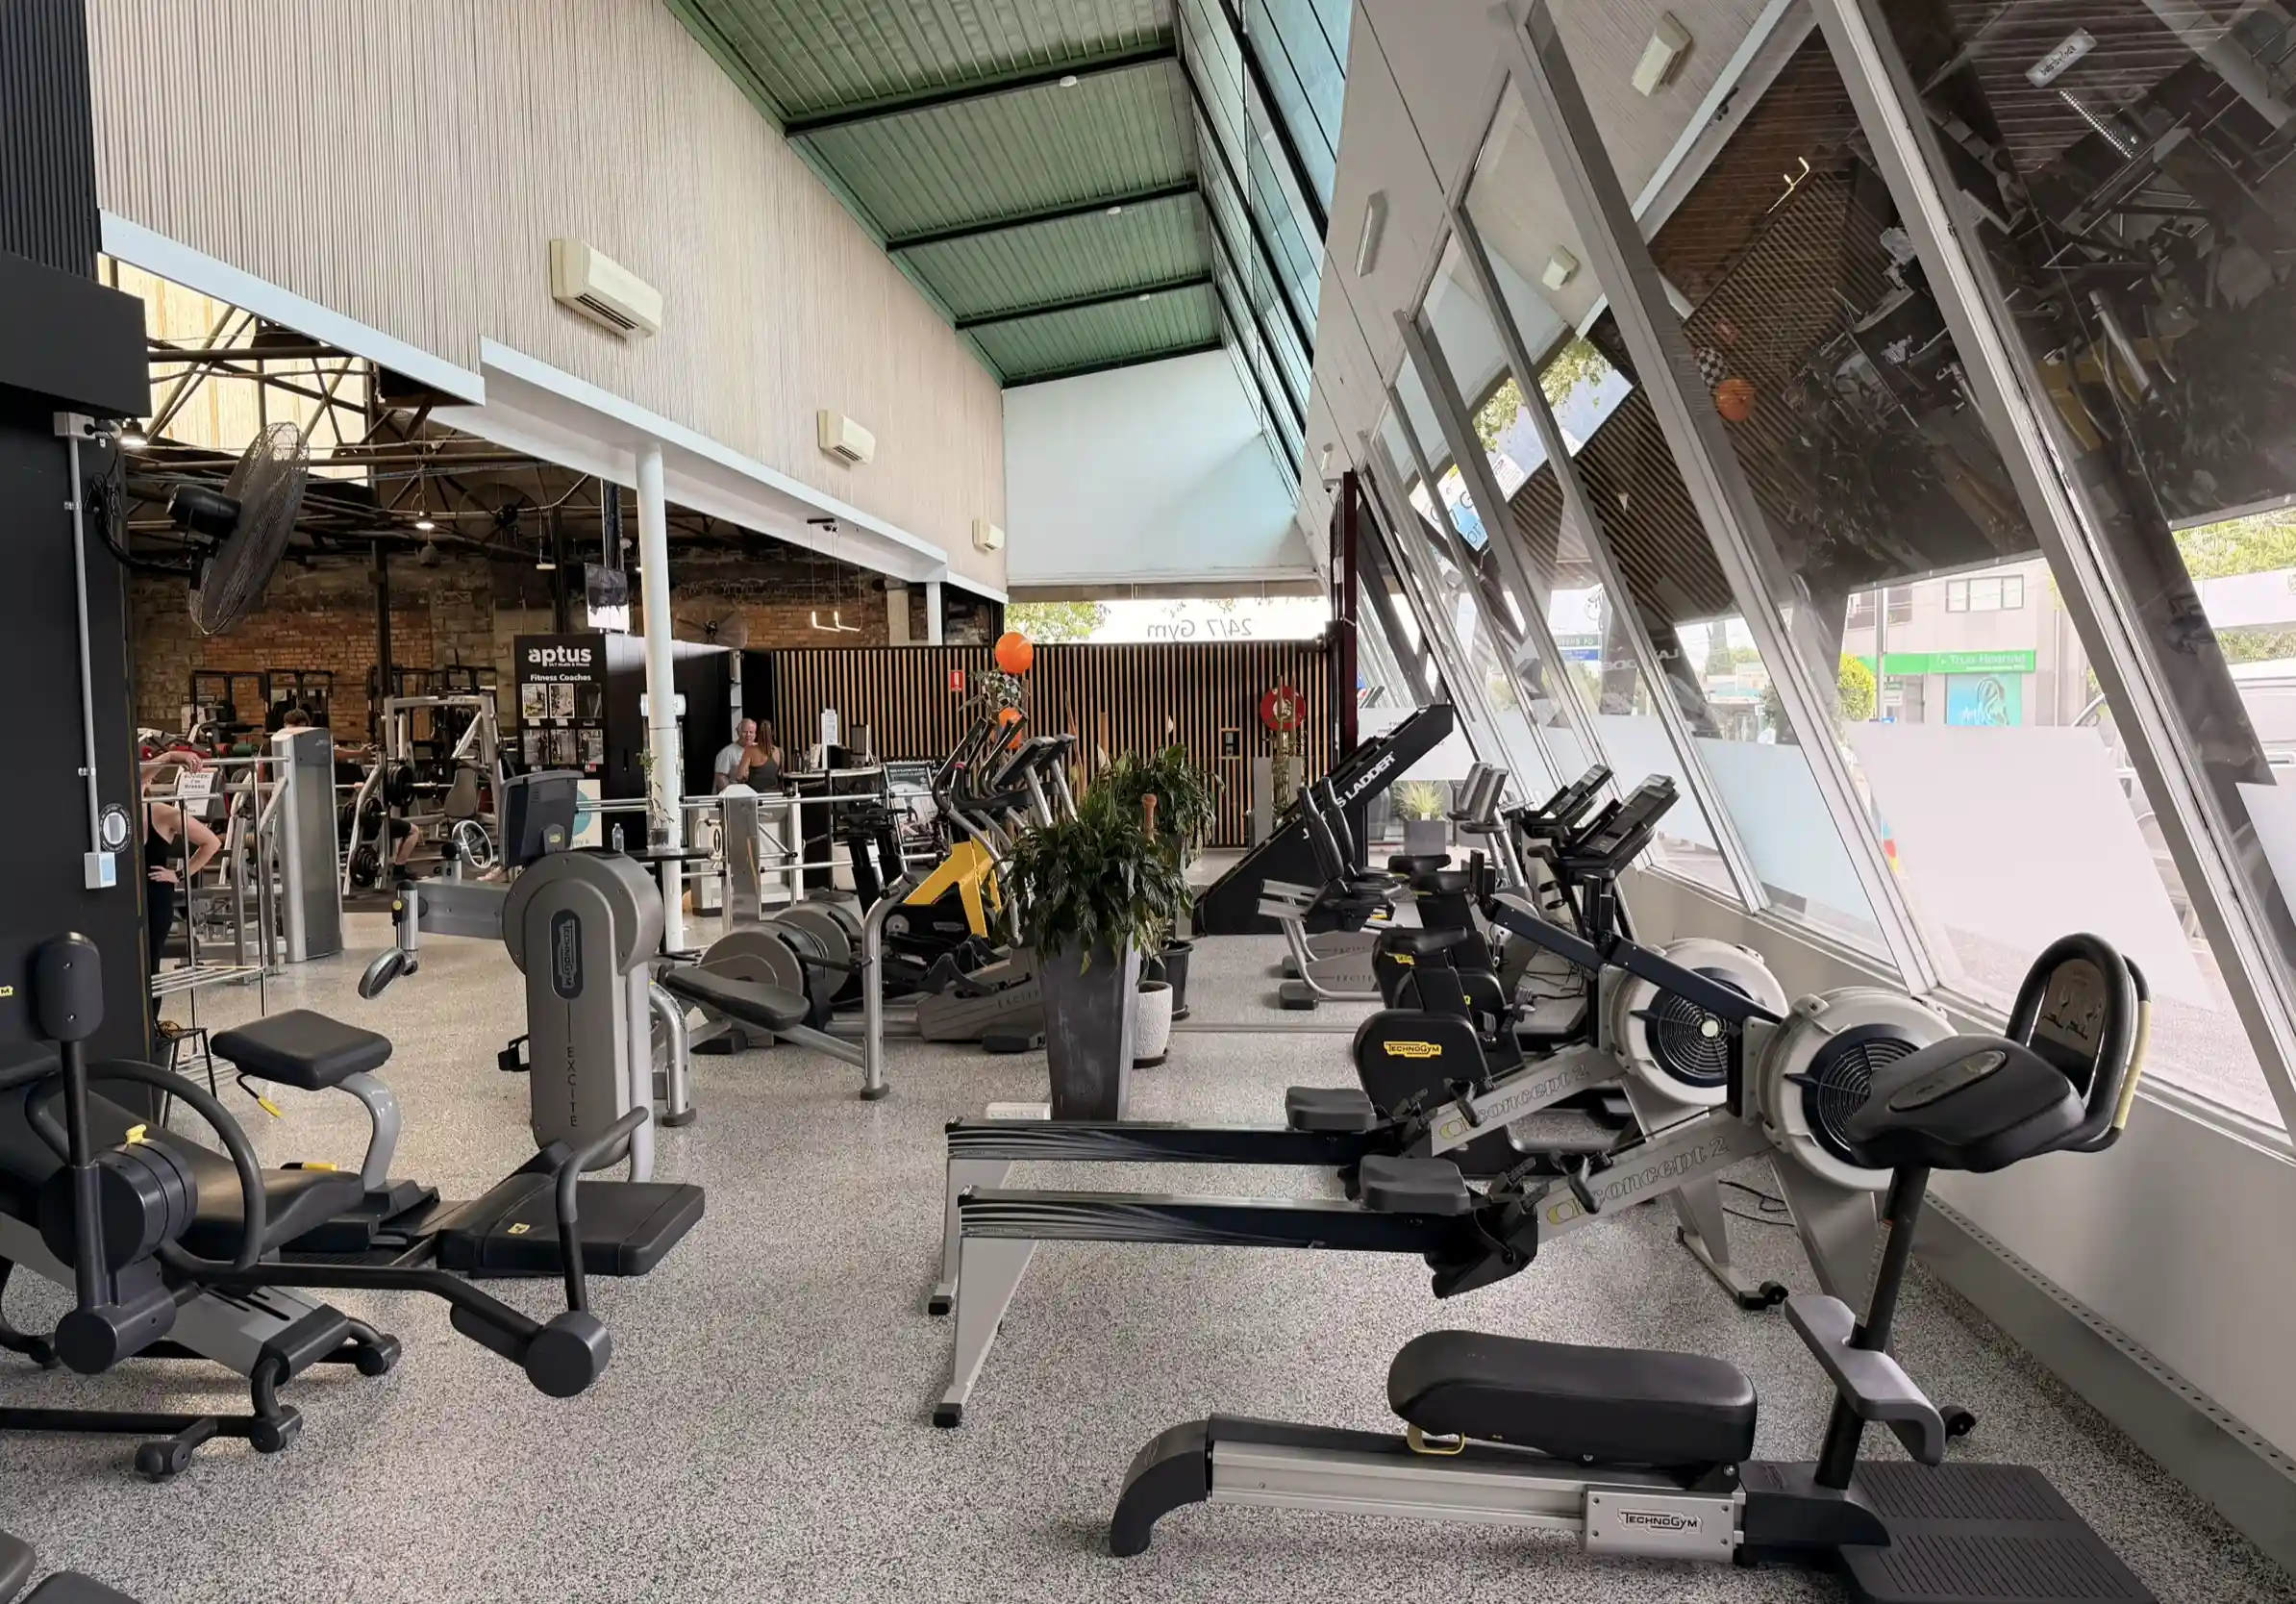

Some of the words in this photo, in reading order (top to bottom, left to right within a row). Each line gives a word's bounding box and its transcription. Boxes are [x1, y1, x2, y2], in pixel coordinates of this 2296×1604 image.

[527, 644, 592, 667] aptus
[530, 673, 558, 682] Fitness
[559, 673, 592, 682] Coaches
[1344, 753, 1397, 801] LADDER
[566, 1046, 579, 1127] EXCITE
[1478, 1072, 1572, 1123] concept
[1572, 1064, 1591, 1082] 2
[1591, 1145, 1709, 1206] concept
[1709, 1136, 1731, 1158] 2
